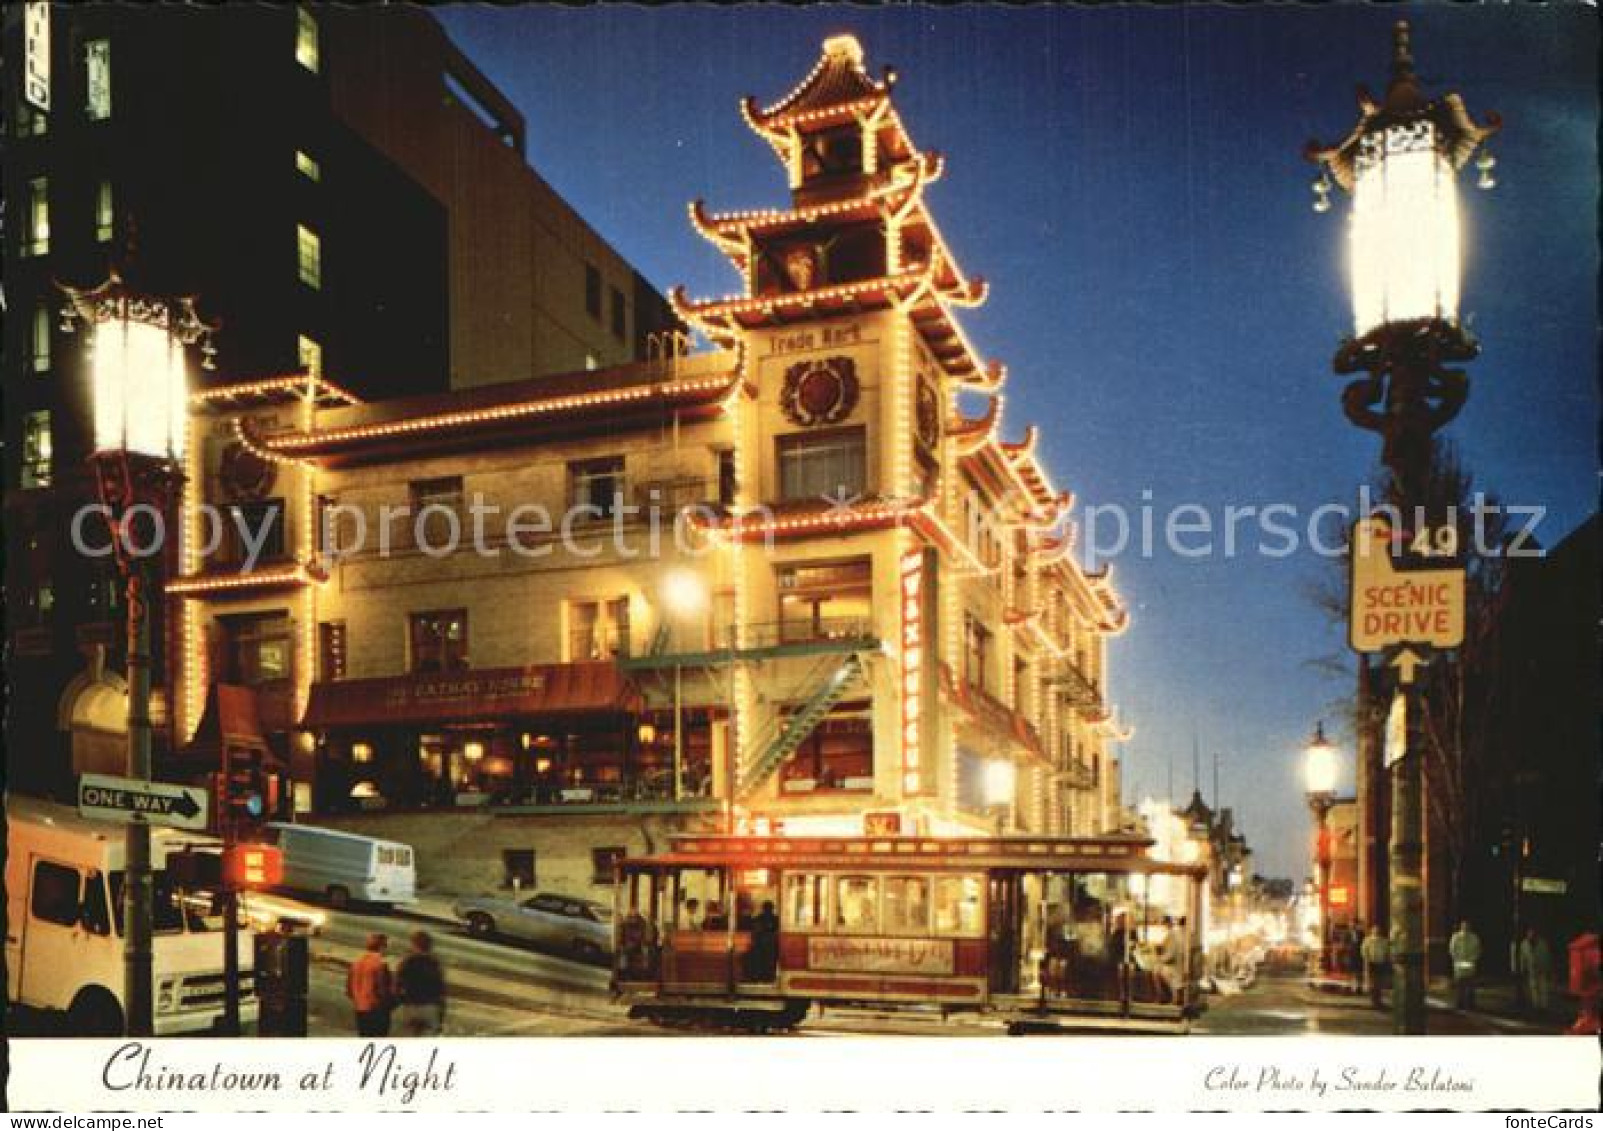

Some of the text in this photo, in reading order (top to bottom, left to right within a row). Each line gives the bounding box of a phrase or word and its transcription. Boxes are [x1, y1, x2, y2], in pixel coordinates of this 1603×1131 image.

[1410, 526, 1458, 557] 49
[1364, 583, 1450, 608] SCENIC
[1364, 608, 1451, 636] DRIVE
[85, 786, 173, 815] ONE WAY
